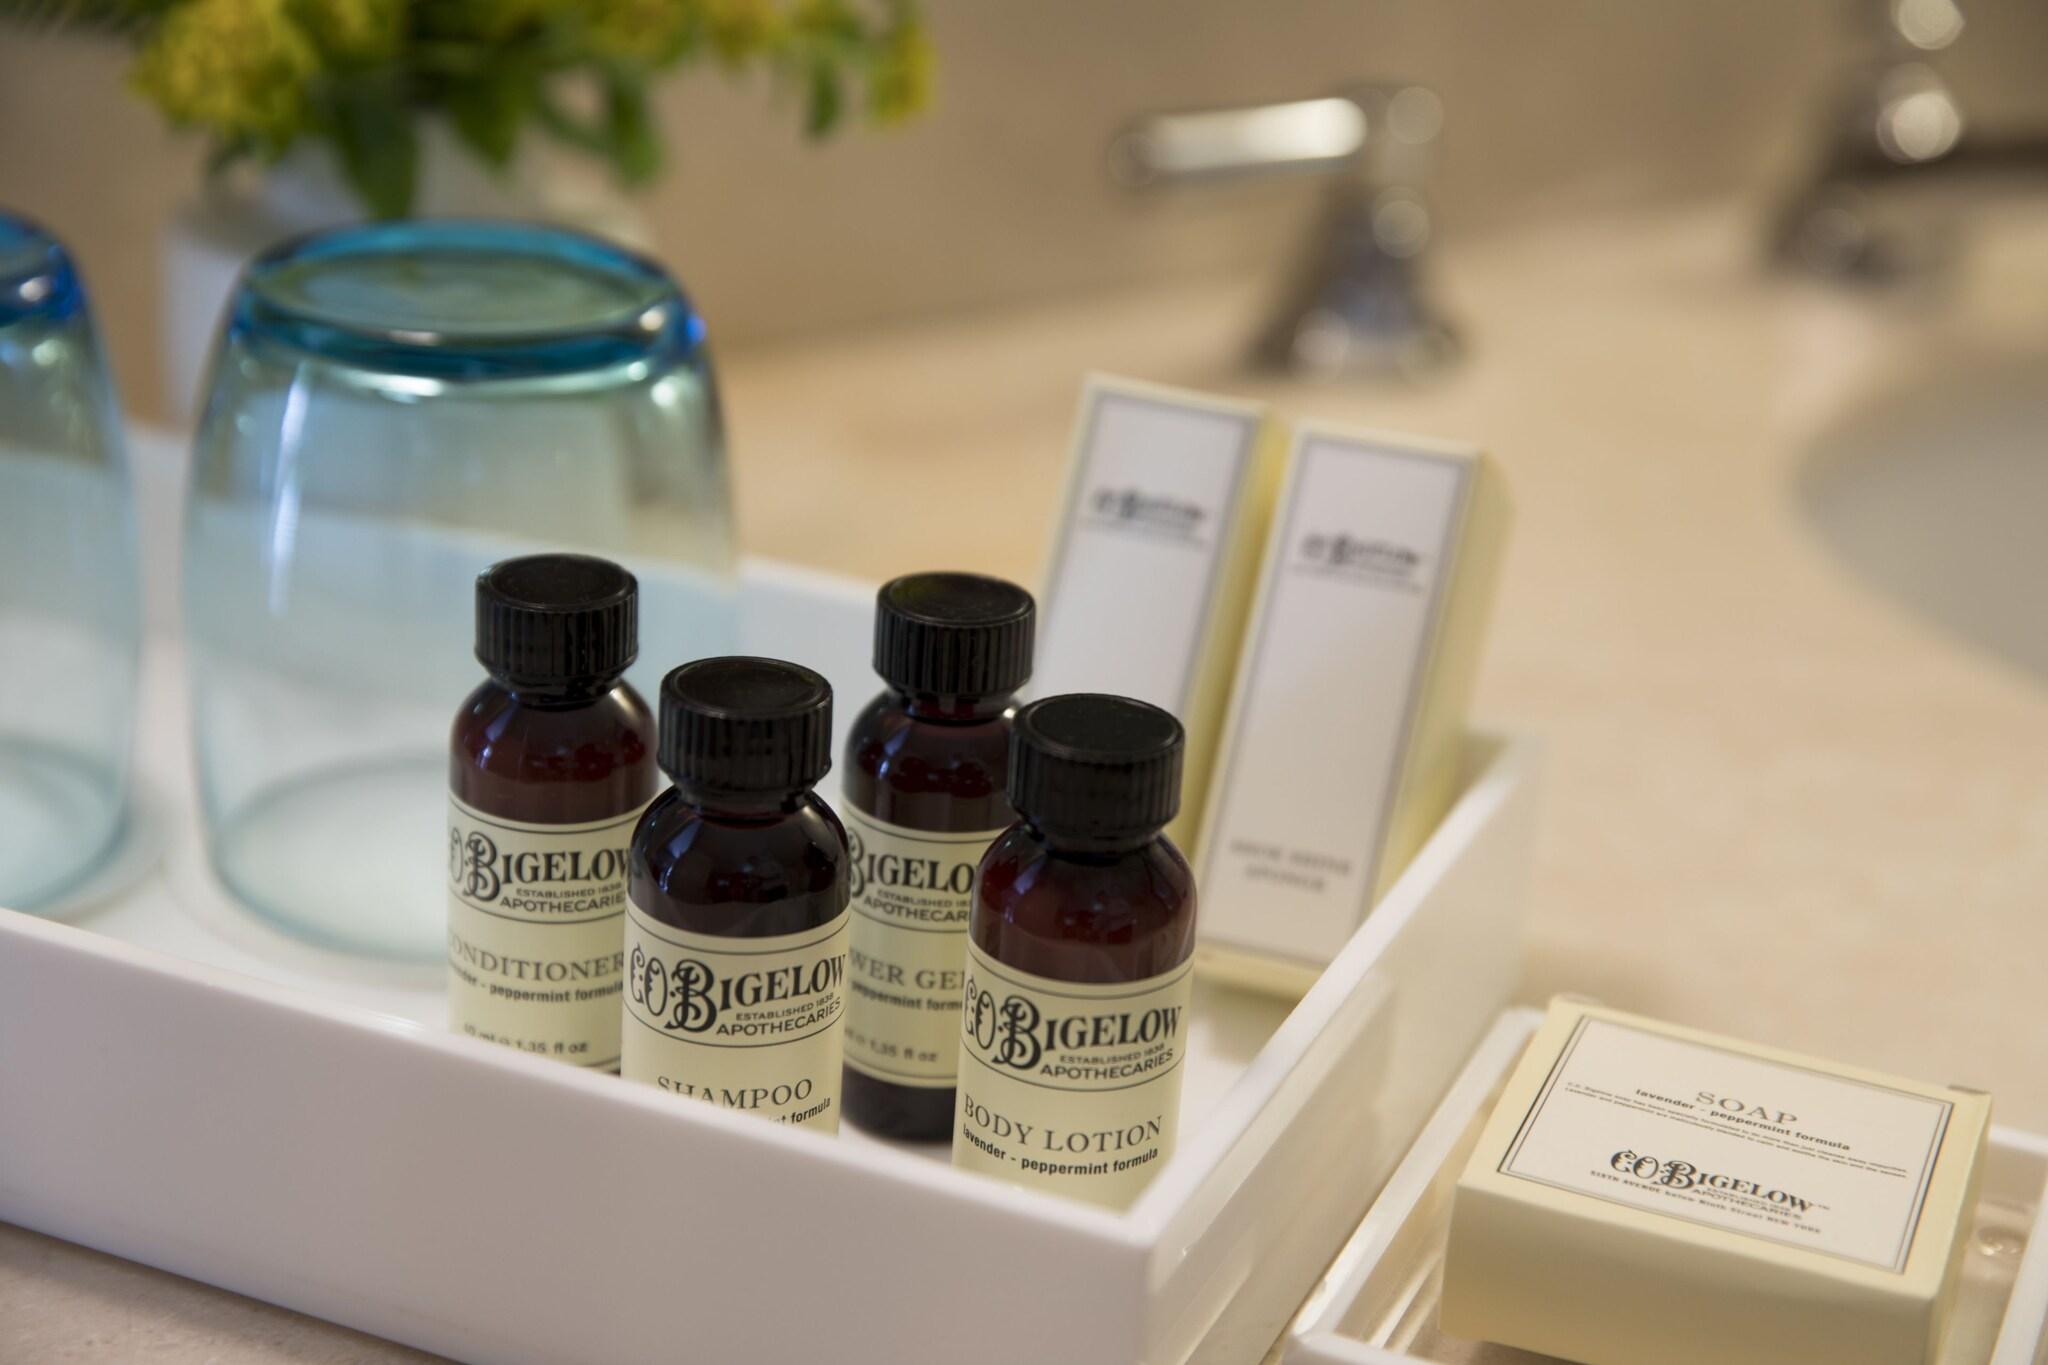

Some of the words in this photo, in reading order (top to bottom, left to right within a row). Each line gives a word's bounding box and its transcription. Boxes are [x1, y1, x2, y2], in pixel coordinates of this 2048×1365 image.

[500, 892, 626, 913] APOTHECARIE
[516, 887, 595, 899] ESTABLISHED
[863, 895, 969, 922] APOTHECAR
[450, 933, 625, 982] ONDITIONER
[848, 945, 904, 986] WER
[489, 983, 571, 1003] peppermint
[664, 953, 847, 1033] BIGELOW
[735, 1002, 814, 1022] ESTABLISHED
[815, 992, 835, 1008] 1838
[716, 997, 841, 1037] APOTHECARIES
[992, 994, 1184, 1070] BIGELOW
[1040, 1048, 1174, 1080] APOTHECARIES
[1059, 1051, 1141, 1065] ESTABLISHED
[657, 1075, 813, 1110] SHAMPOO
[1695, 1091, 1798, 1124] SOAP
[790, 1097, 832, 1125] formula
[963, 1093, 1034, 1146] BODY
[1045, 1115, 1163, 1154] LOTION
[1635, 1088, 1696, 1110] lavender
[1709, 1109, 1791, 1137] peppermint
[1795, 1131, 1852, 1151] formula
[962, 1124, 1007, 1160] lavender
[1020, 1157, 1109, 1176] peppermint
[1113, 1148, 1159, 1173] formula
[1651, 1159, 1815, 1212] BIGELOW
